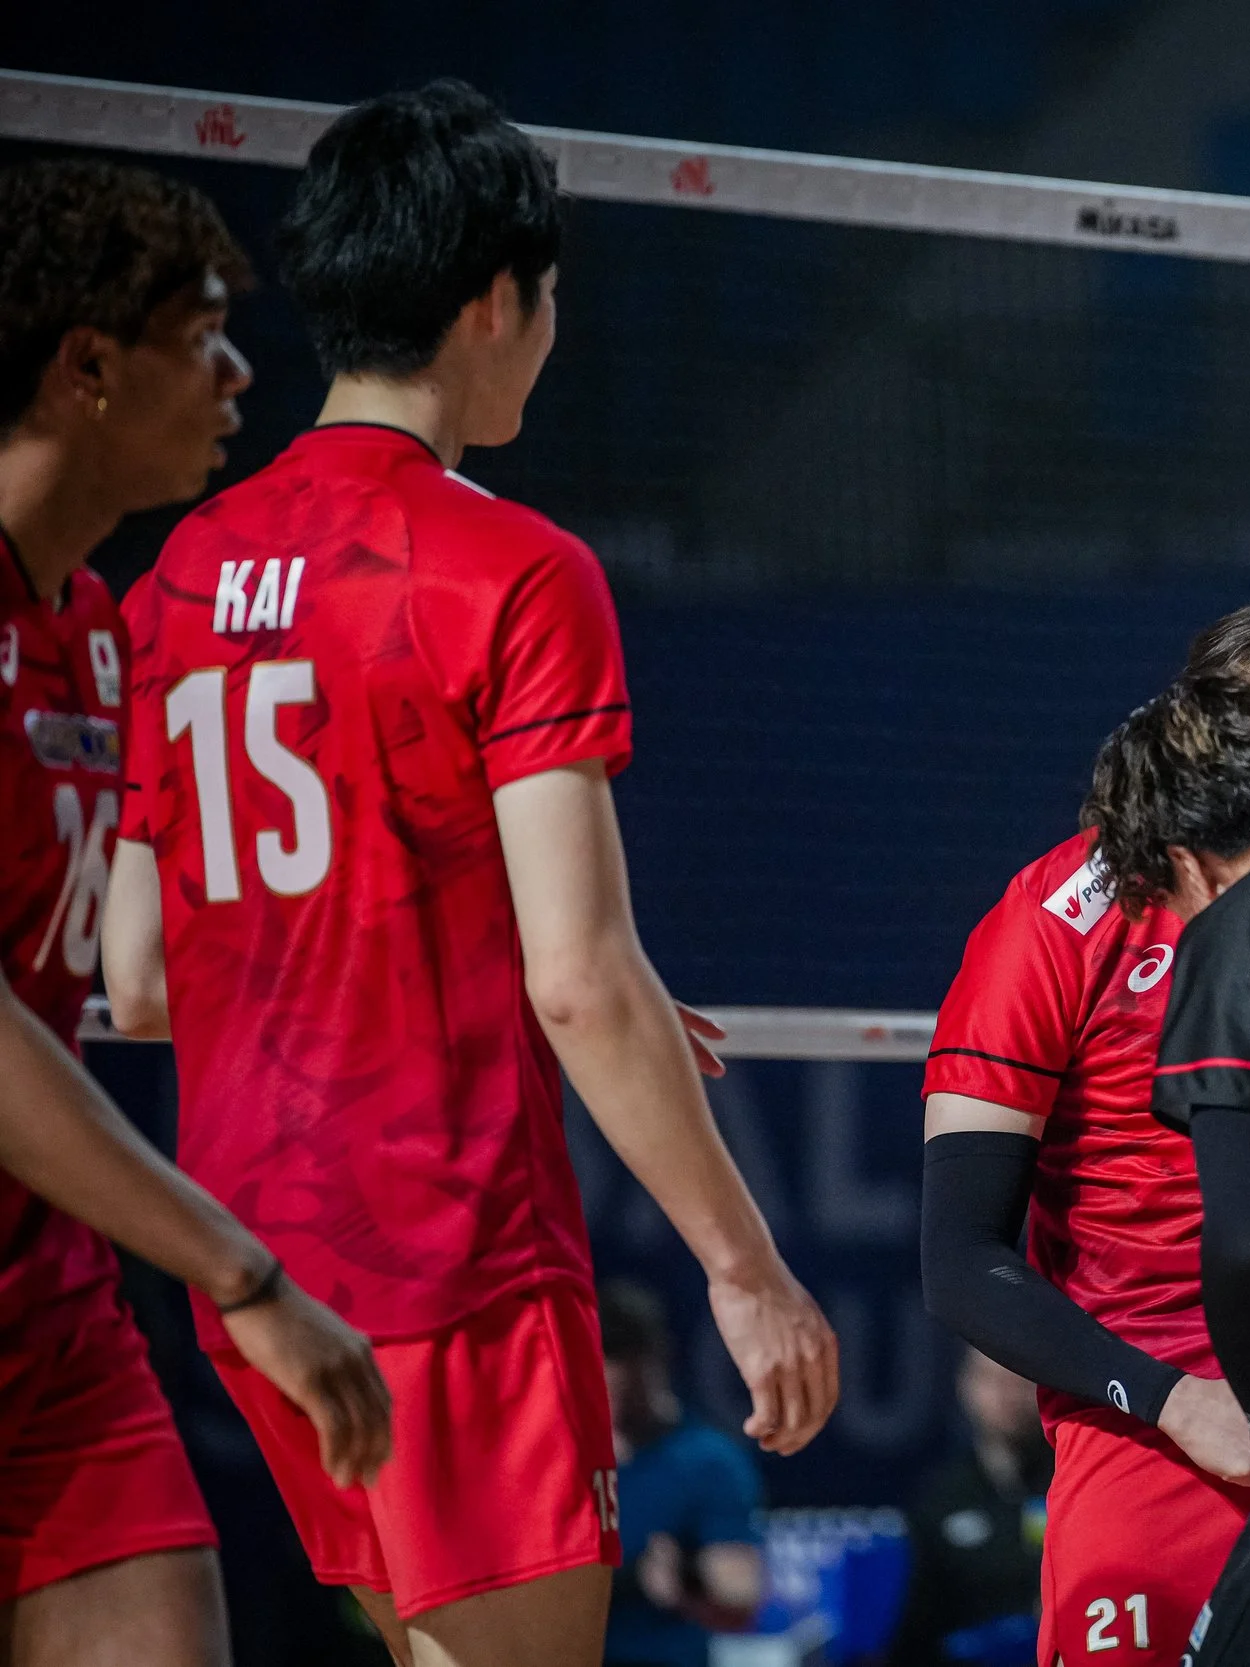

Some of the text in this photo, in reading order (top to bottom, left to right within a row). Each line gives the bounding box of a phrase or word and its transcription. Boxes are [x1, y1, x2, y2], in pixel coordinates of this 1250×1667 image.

[212, 557, 306, 633] KAI
[165, 657, 334, 904] 15
[1085, 1593, 1150, 1653] 21
